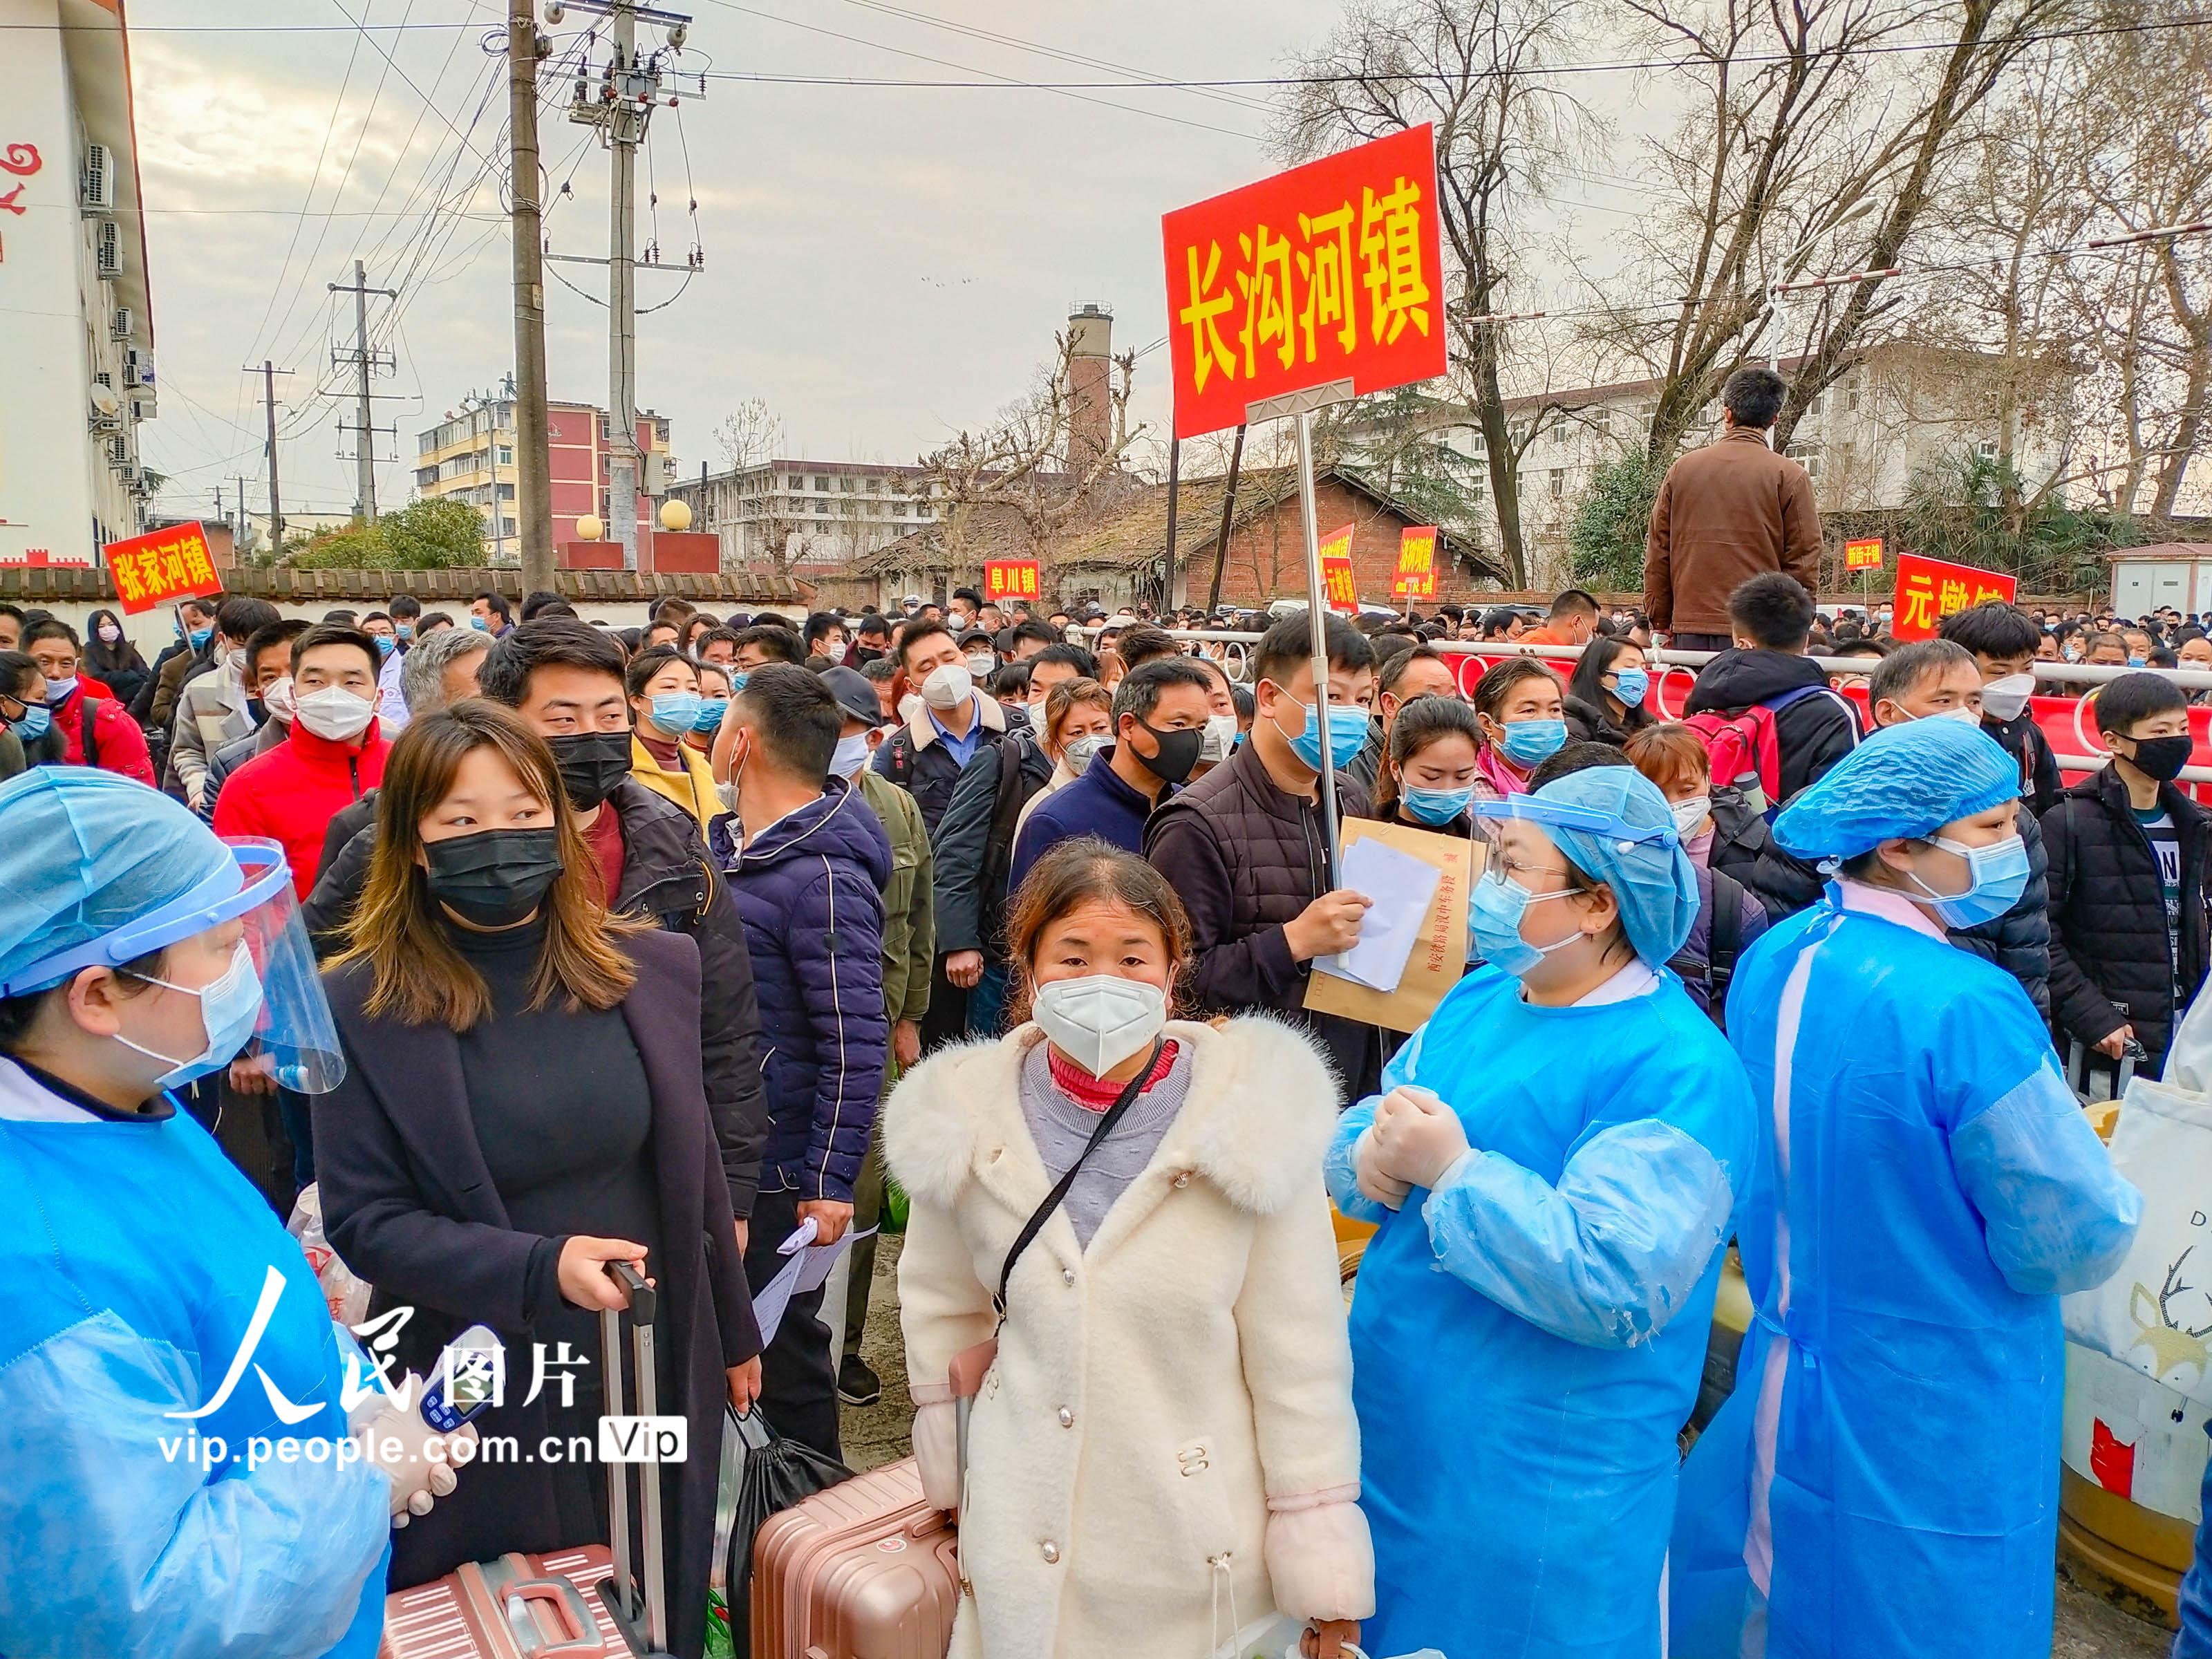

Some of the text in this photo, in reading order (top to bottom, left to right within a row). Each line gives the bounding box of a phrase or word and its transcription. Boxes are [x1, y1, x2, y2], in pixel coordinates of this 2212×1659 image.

[1179, 176, 1430, 395] 长沟河镇
[112, 535, 214, 601] 张家河镇
[1847, 543, 1880, 565] 新街子镇
[990, 566, 1036, 594] 阜川镇
[1327, 567, 1356, 604] 元墩镇
